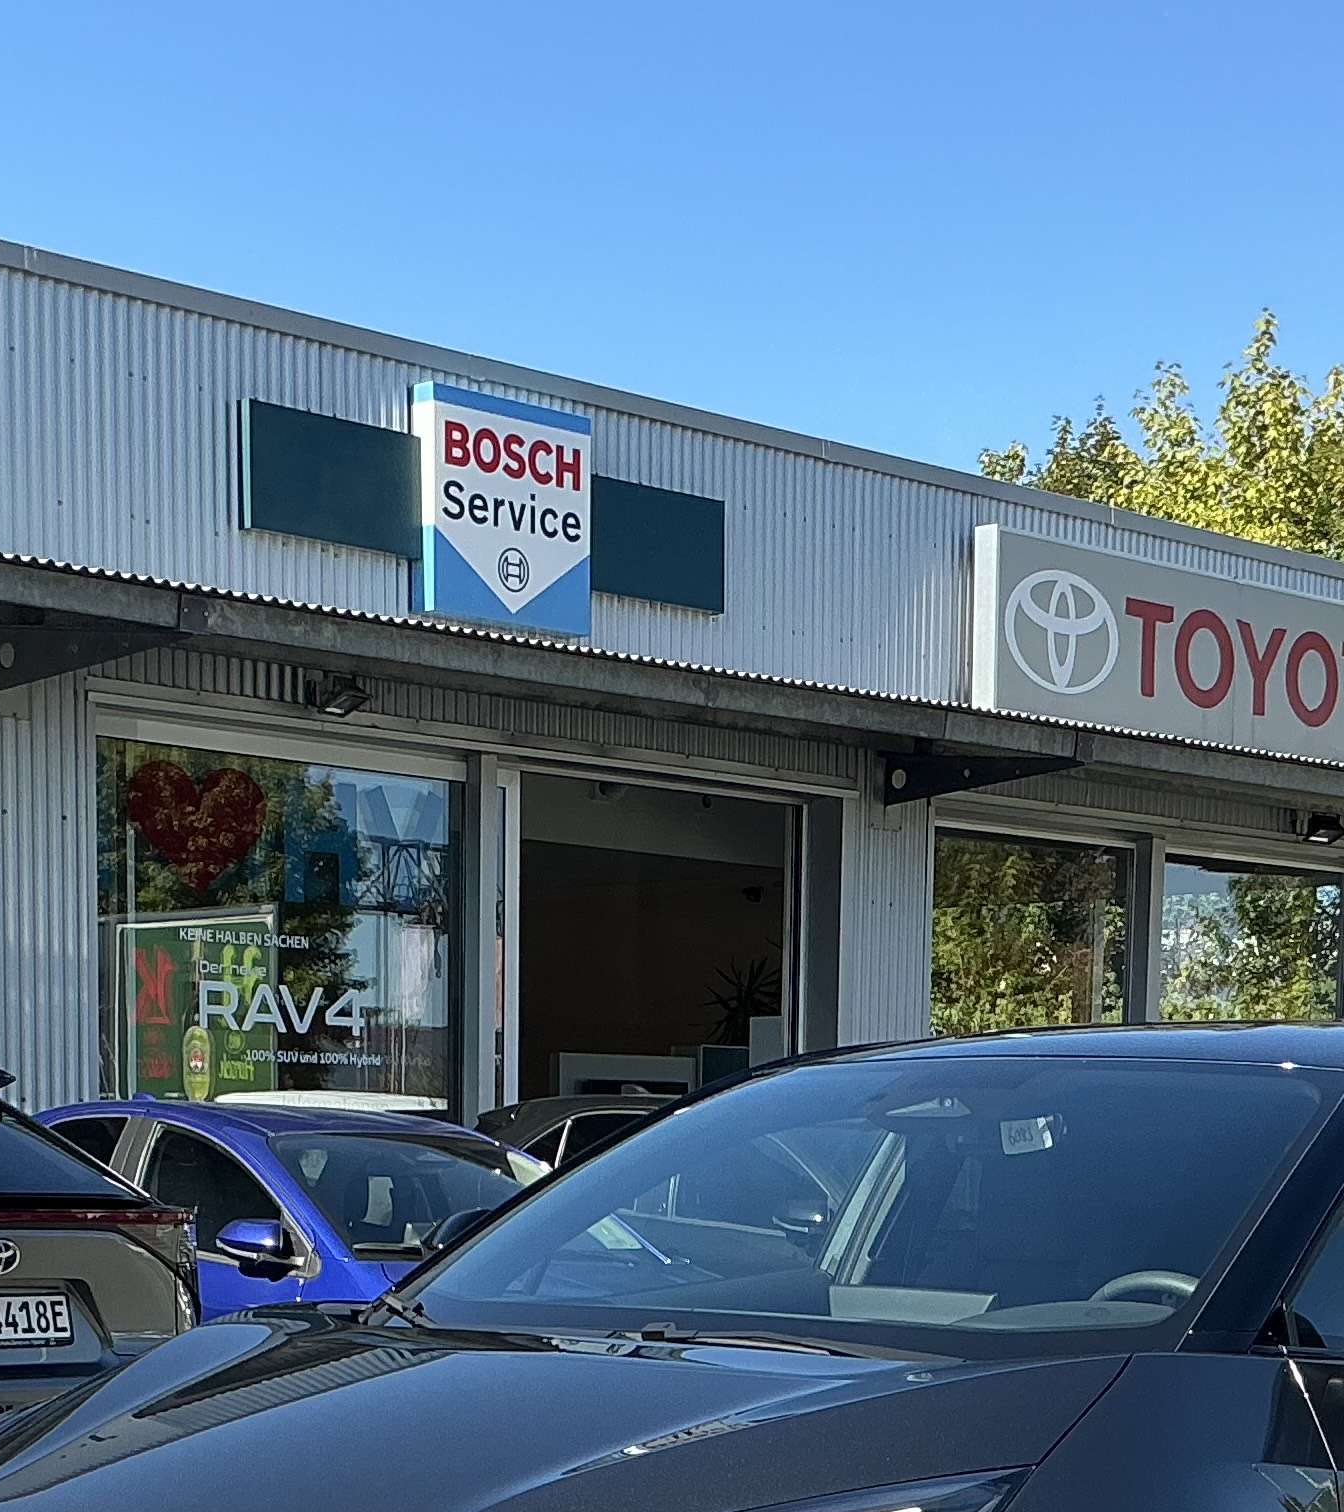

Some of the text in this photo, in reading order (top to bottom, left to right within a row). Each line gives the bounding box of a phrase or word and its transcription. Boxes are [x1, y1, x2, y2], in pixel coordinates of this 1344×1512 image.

[444, 419, 582, 492] BOSCH
[442, 479, 582, 544] Service
[179, 928, 310, 949] KEINE HALBEN SACHEN
[200, 960, 267, 977] Der neue
[199, 980, 366, 1037] RAV4
[246, 1049, 275, 1063] 100%
[276, 1051, 299, 1064] SUV
[299, 1053, 318, 1065] und
[319, 1052, 349, 1066] 100%
[349, 1053, 381, 1069] Hybrid
